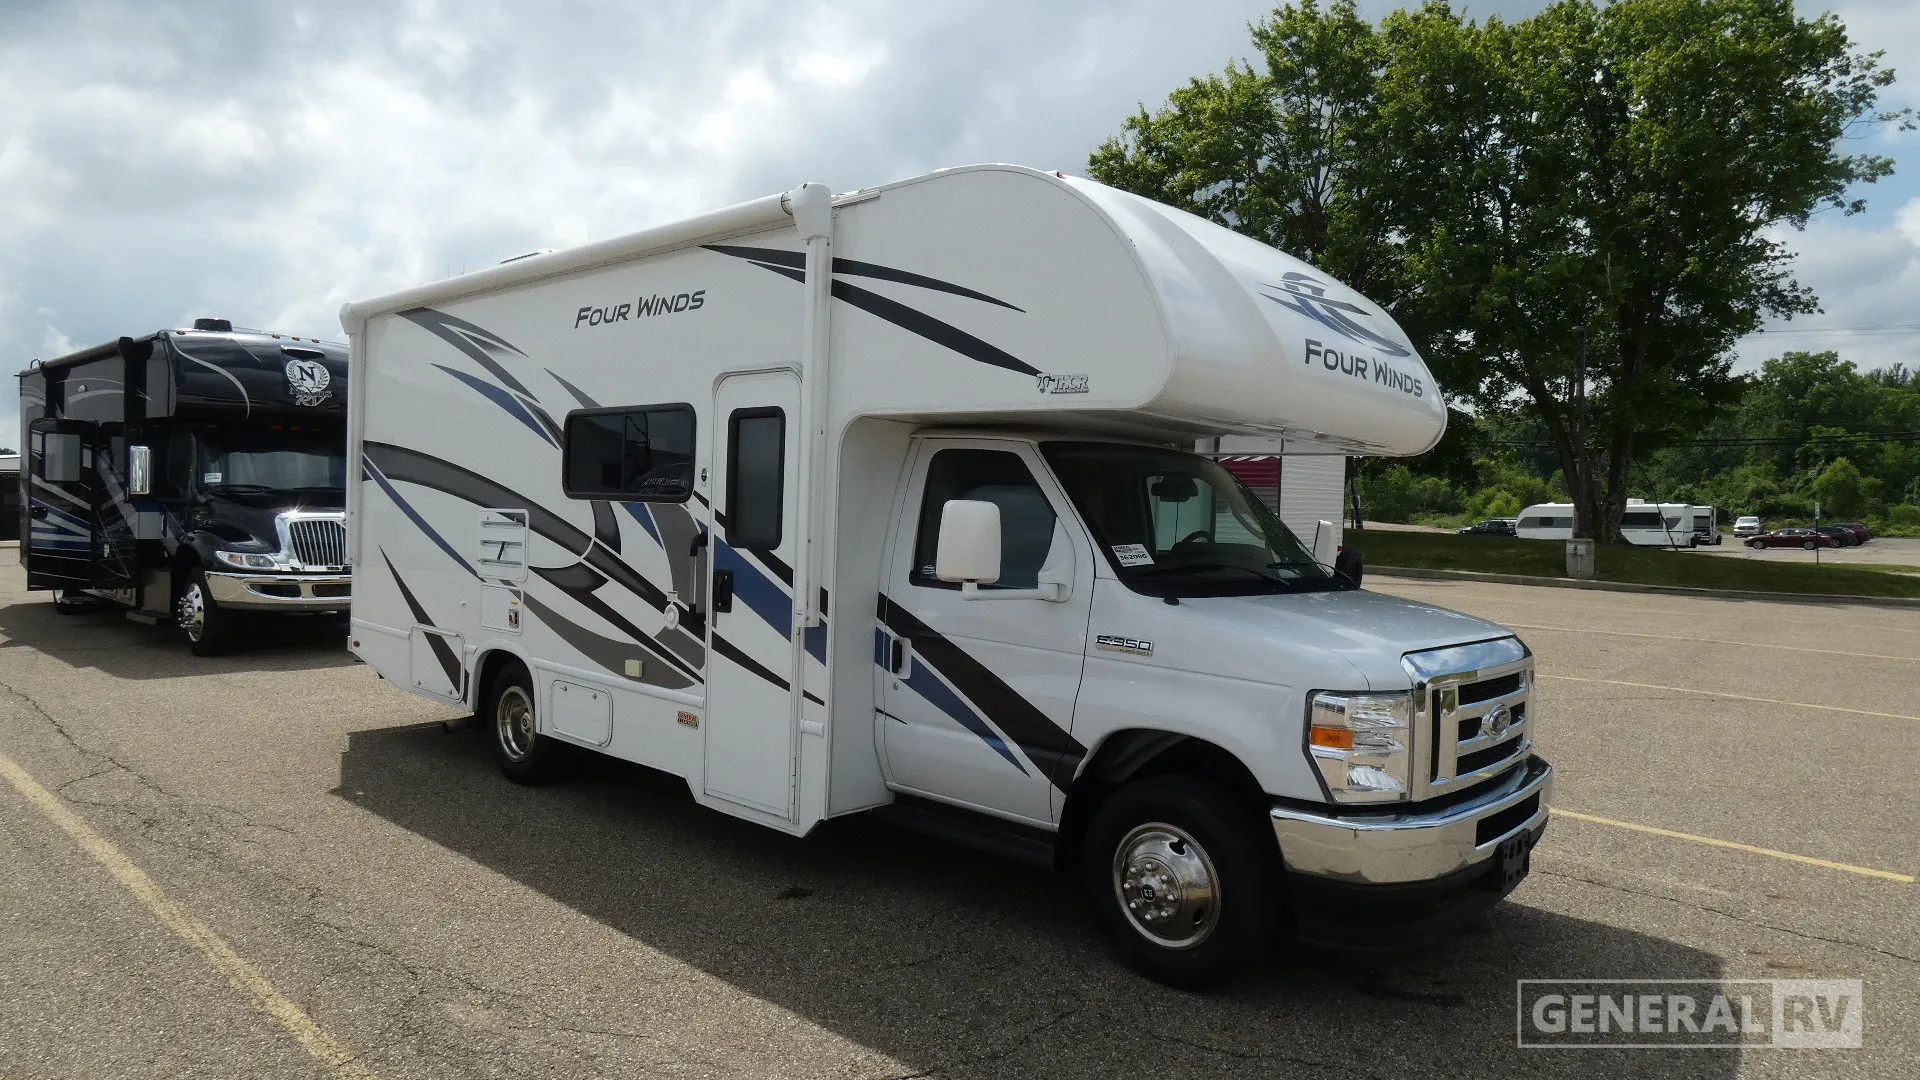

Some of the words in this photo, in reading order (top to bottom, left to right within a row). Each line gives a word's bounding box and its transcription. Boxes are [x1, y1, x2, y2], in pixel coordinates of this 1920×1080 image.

[574, 303, 631, 329] FOUR
[637, 289, 706, 319] WINDS
[1305, 338, 1367, 380] FOUR
[1372, 357, 1422, 397] WINDS
